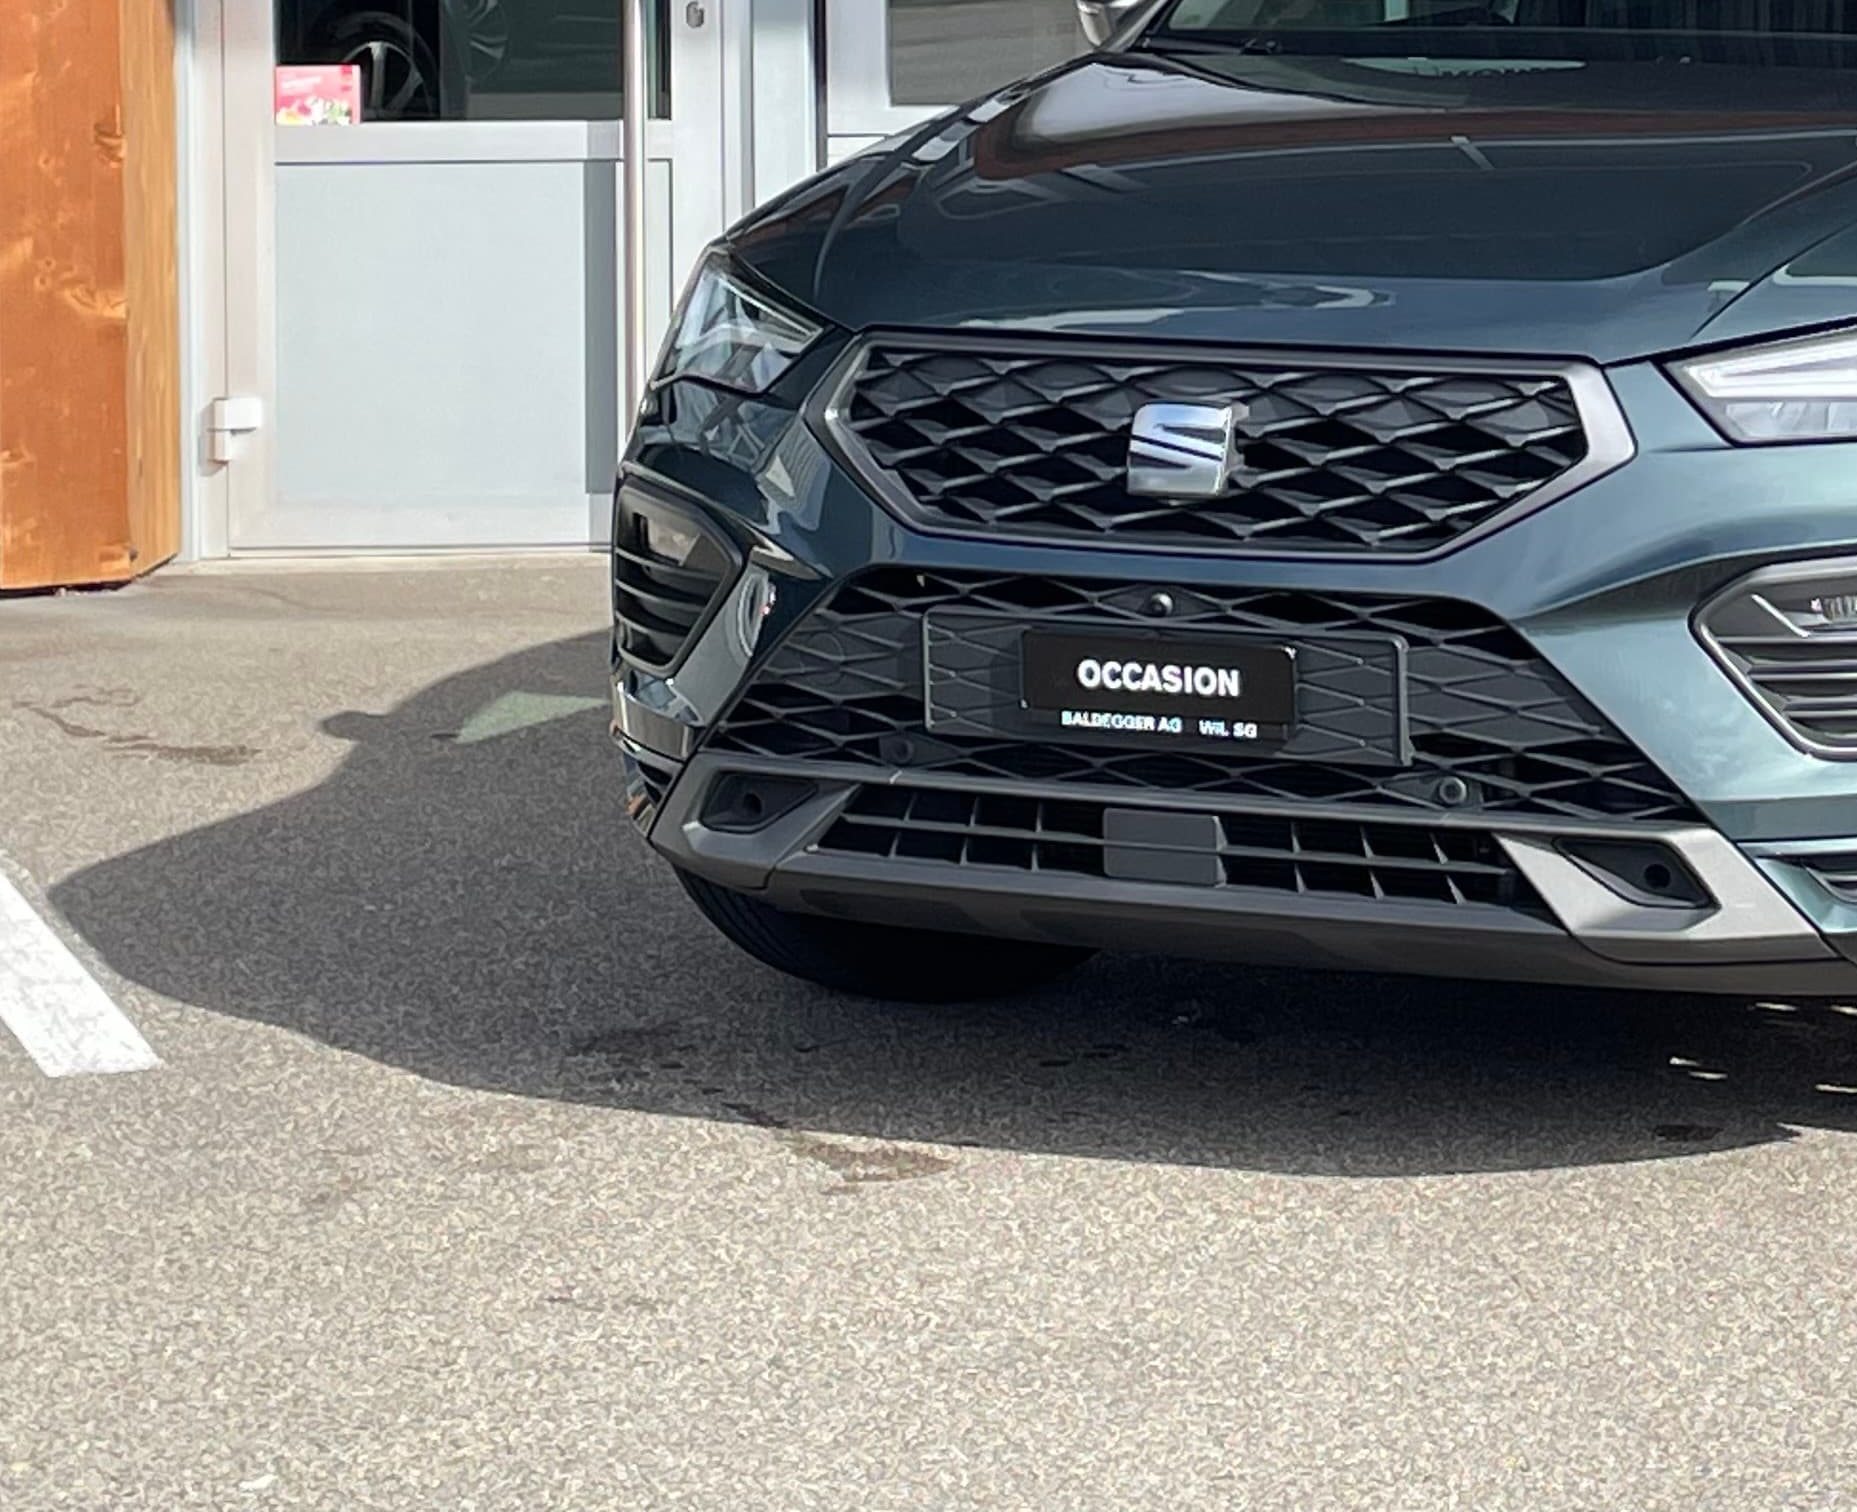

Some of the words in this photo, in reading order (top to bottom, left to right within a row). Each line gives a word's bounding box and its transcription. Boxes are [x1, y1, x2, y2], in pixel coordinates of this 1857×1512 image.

[1077, 658, 1241, 697] OCCASION
[1061, 710, 1155, 732] BALDEGGER
[1157, 717, 1184, 733] AG
[1232, 721, 1258, 738] SG
